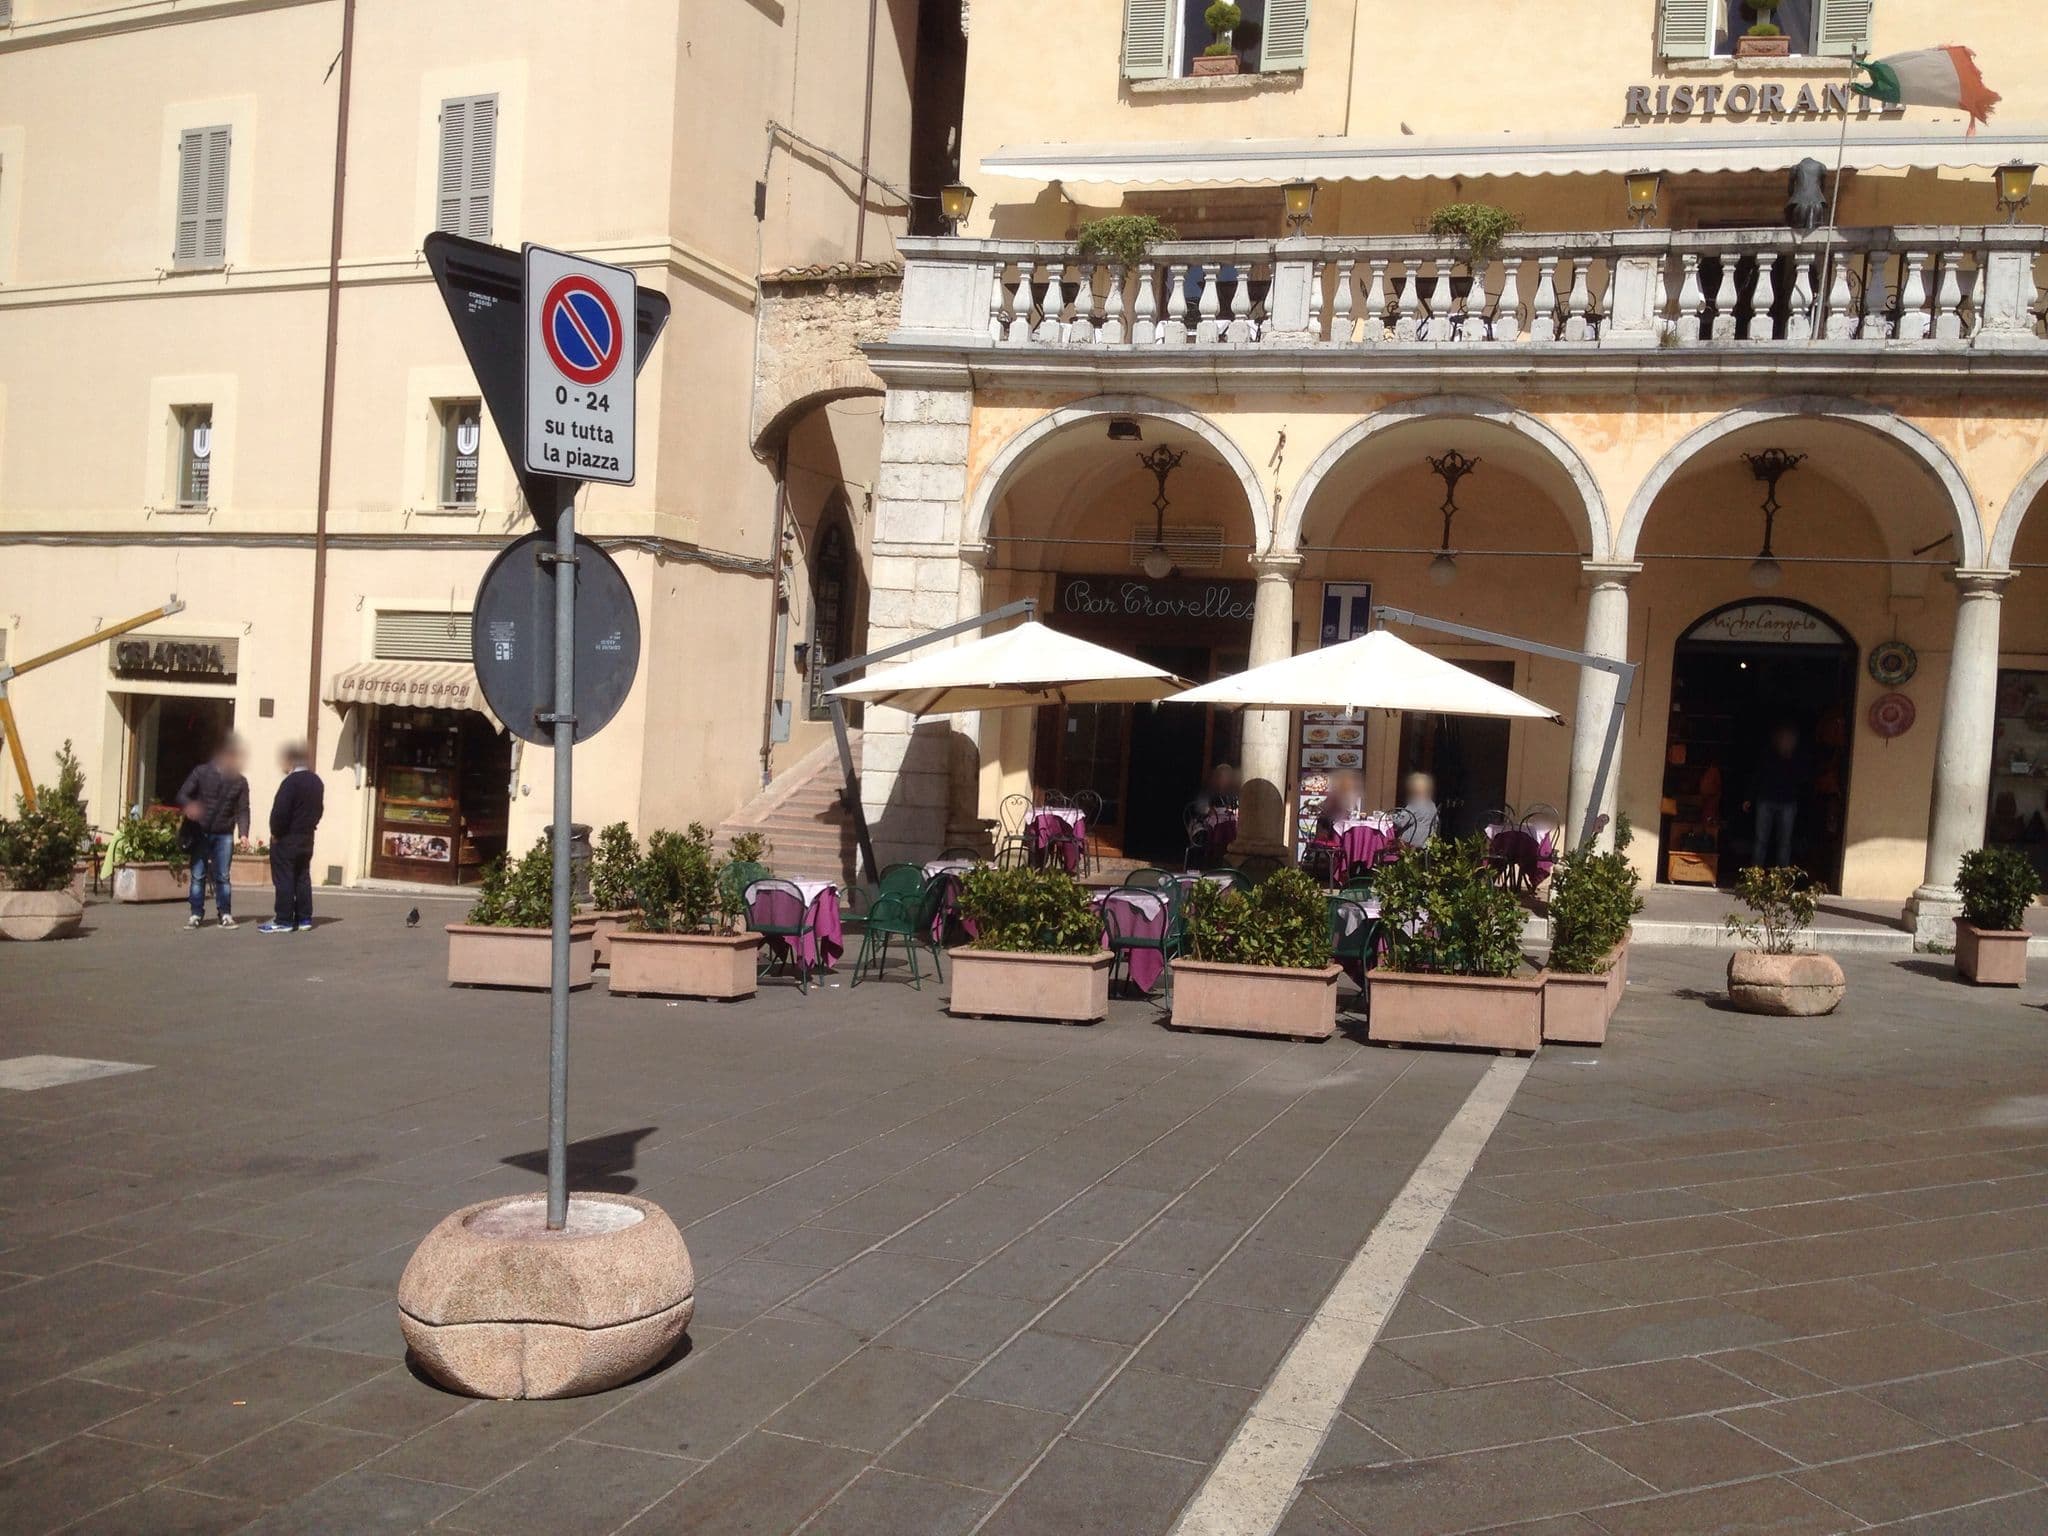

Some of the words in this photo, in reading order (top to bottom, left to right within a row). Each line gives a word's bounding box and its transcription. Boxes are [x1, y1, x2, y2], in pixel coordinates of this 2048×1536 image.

[555, 385, 568, 405] 0
[586, 391, 610, 413] 24
[545, 419, 565, 436] su
[571, 421, 614, 444] tutta
[543, 442, 561, 463] la
[566, 447, 620, 472] piazza
[1065, 580, 1118, 613] Bar
[1327, 584, 1367, 640] T
[342, 679, 355, 689] LA
[358, 679, 407, 693] BOTTEGA
[409, 683, 428, 695] DEI
[430, 684, 470, 697] SAPORI
